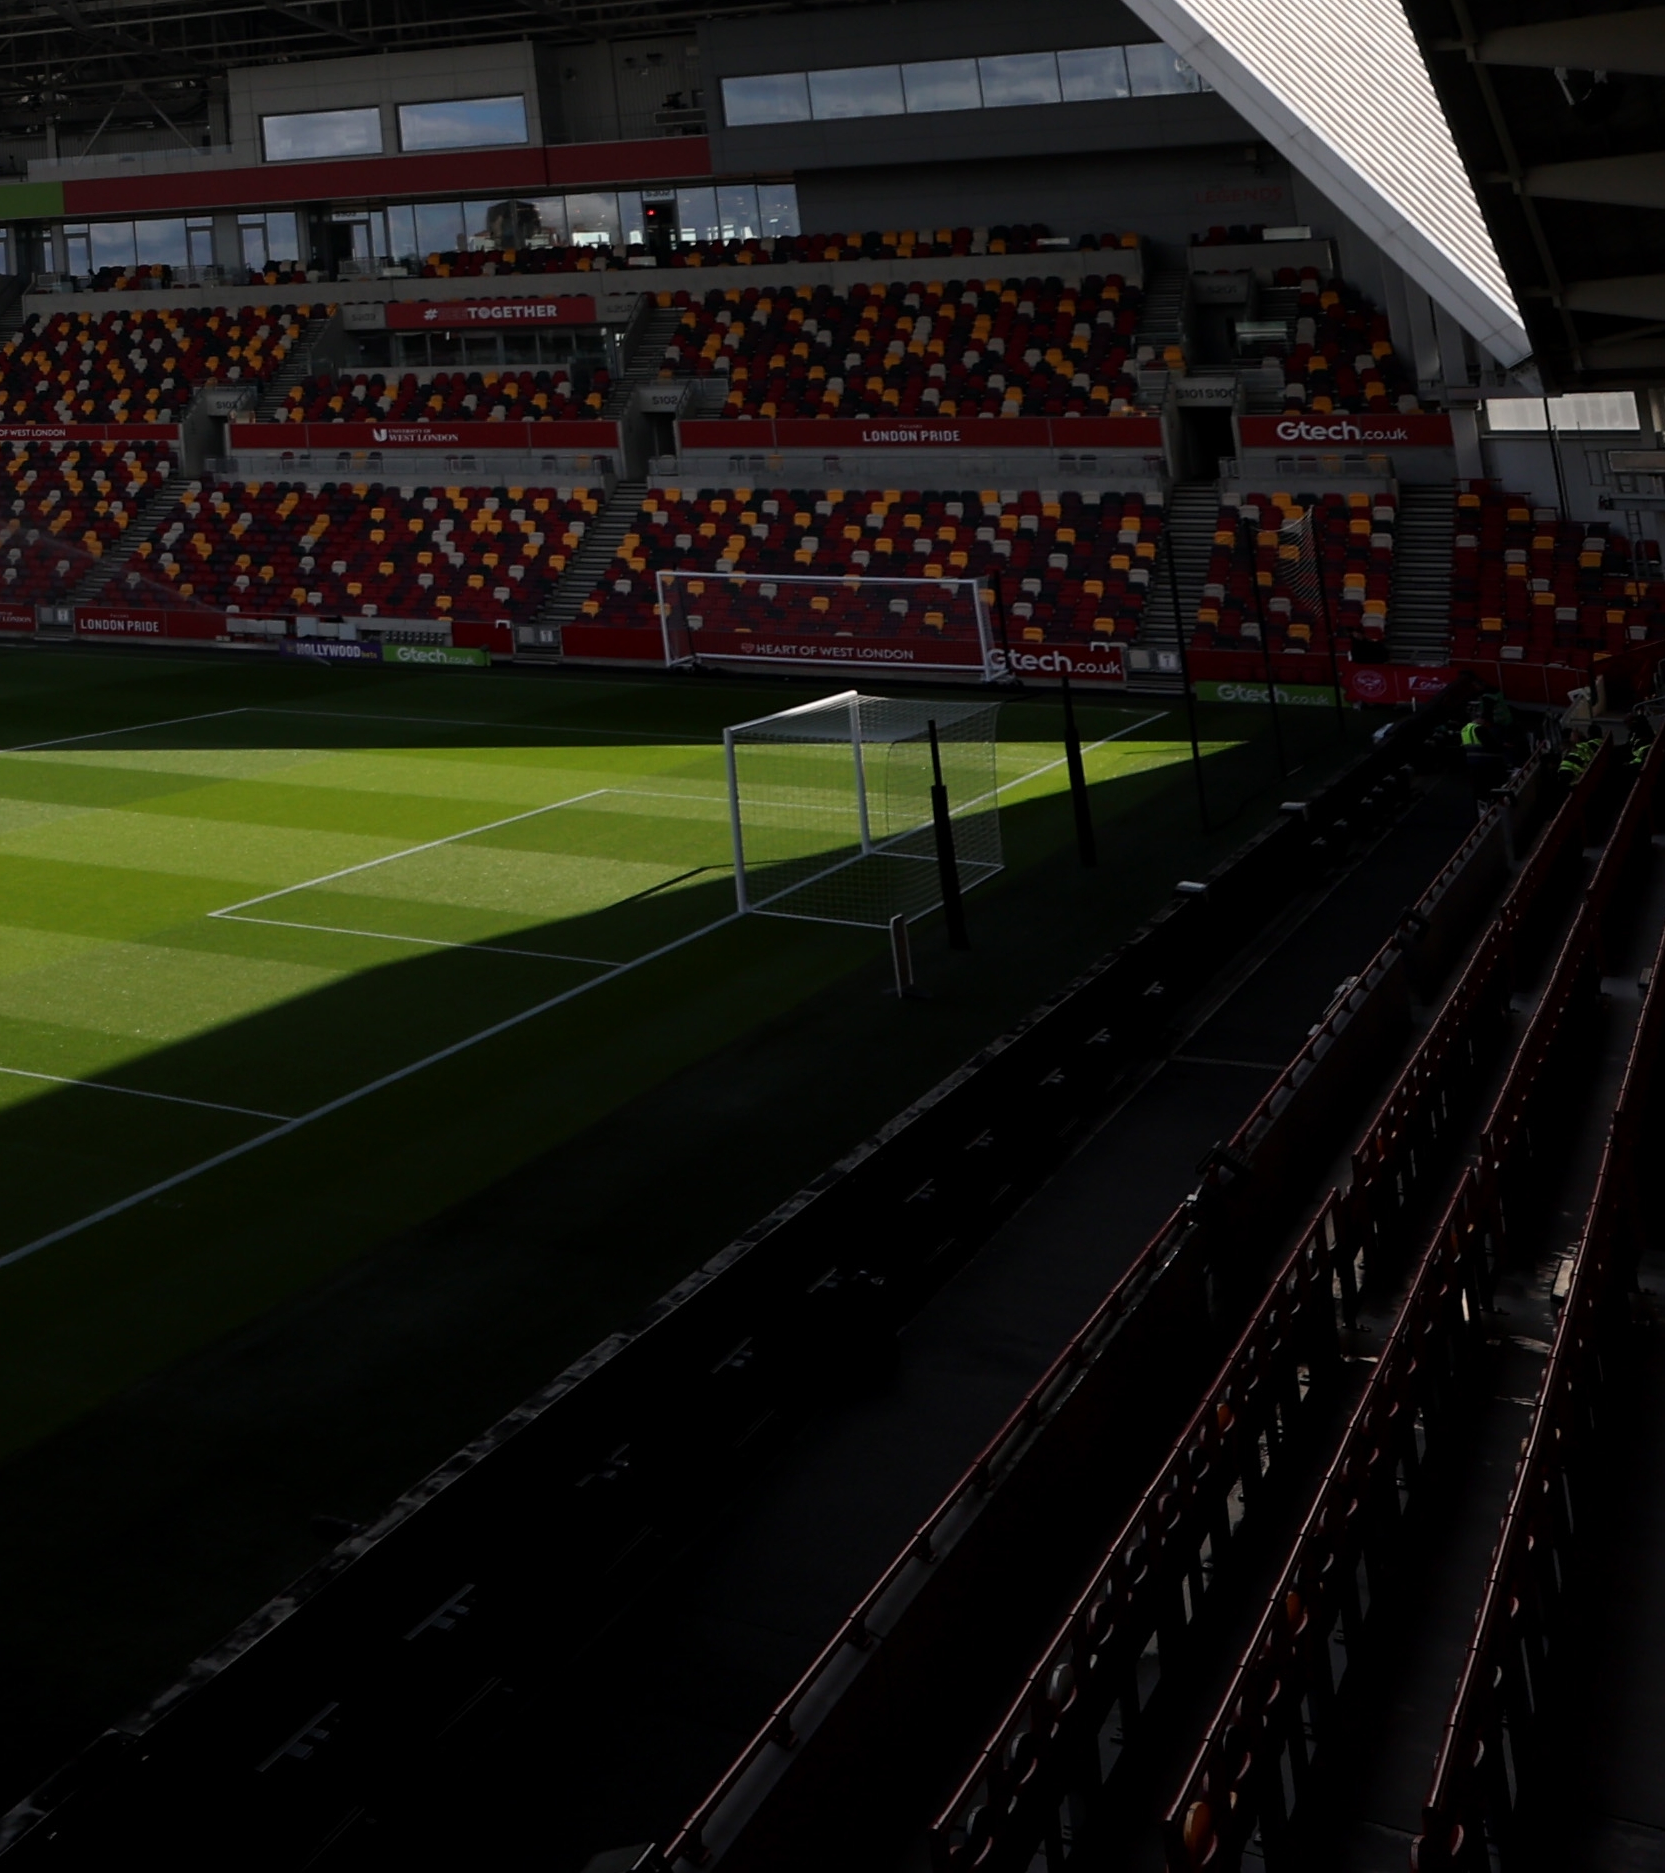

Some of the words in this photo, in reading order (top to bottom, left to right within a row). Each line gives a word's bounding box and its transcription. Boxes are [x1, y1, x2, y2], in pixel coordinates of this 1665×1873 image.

[1194, 186, 1283, 204] LEGENDS
[652, 396, 678, 405] S102
[10, 429, 31, 437] WEST
[32, 429, 66, 437] LONDON
[388, 434, 415, 442] WEST
[416, 434, 459, 442] LONDON
[861, 430, 918, 442] LONDON
[919, 430, 961, 442] PRIDE
[1275, 420, 1409, 441] Gtech.co.uk
[2, 614, 32, 623] LONDON
[80, 618, 125, 631] LONDON
[126, 620, 159, 633] PRIDE
[397, 646, 475, 666] Gtech.co.uk
[756, 643, 798, 655] HEART
[799, 645, 818, 656] OF
[819, 646, 854, 658] WEST
[856, 648, 914, 660] LONDON
[986, 647, 1121, 675] Gtech.co.uk
[1216, 683, 1329, 706] Gtech.co.uk
